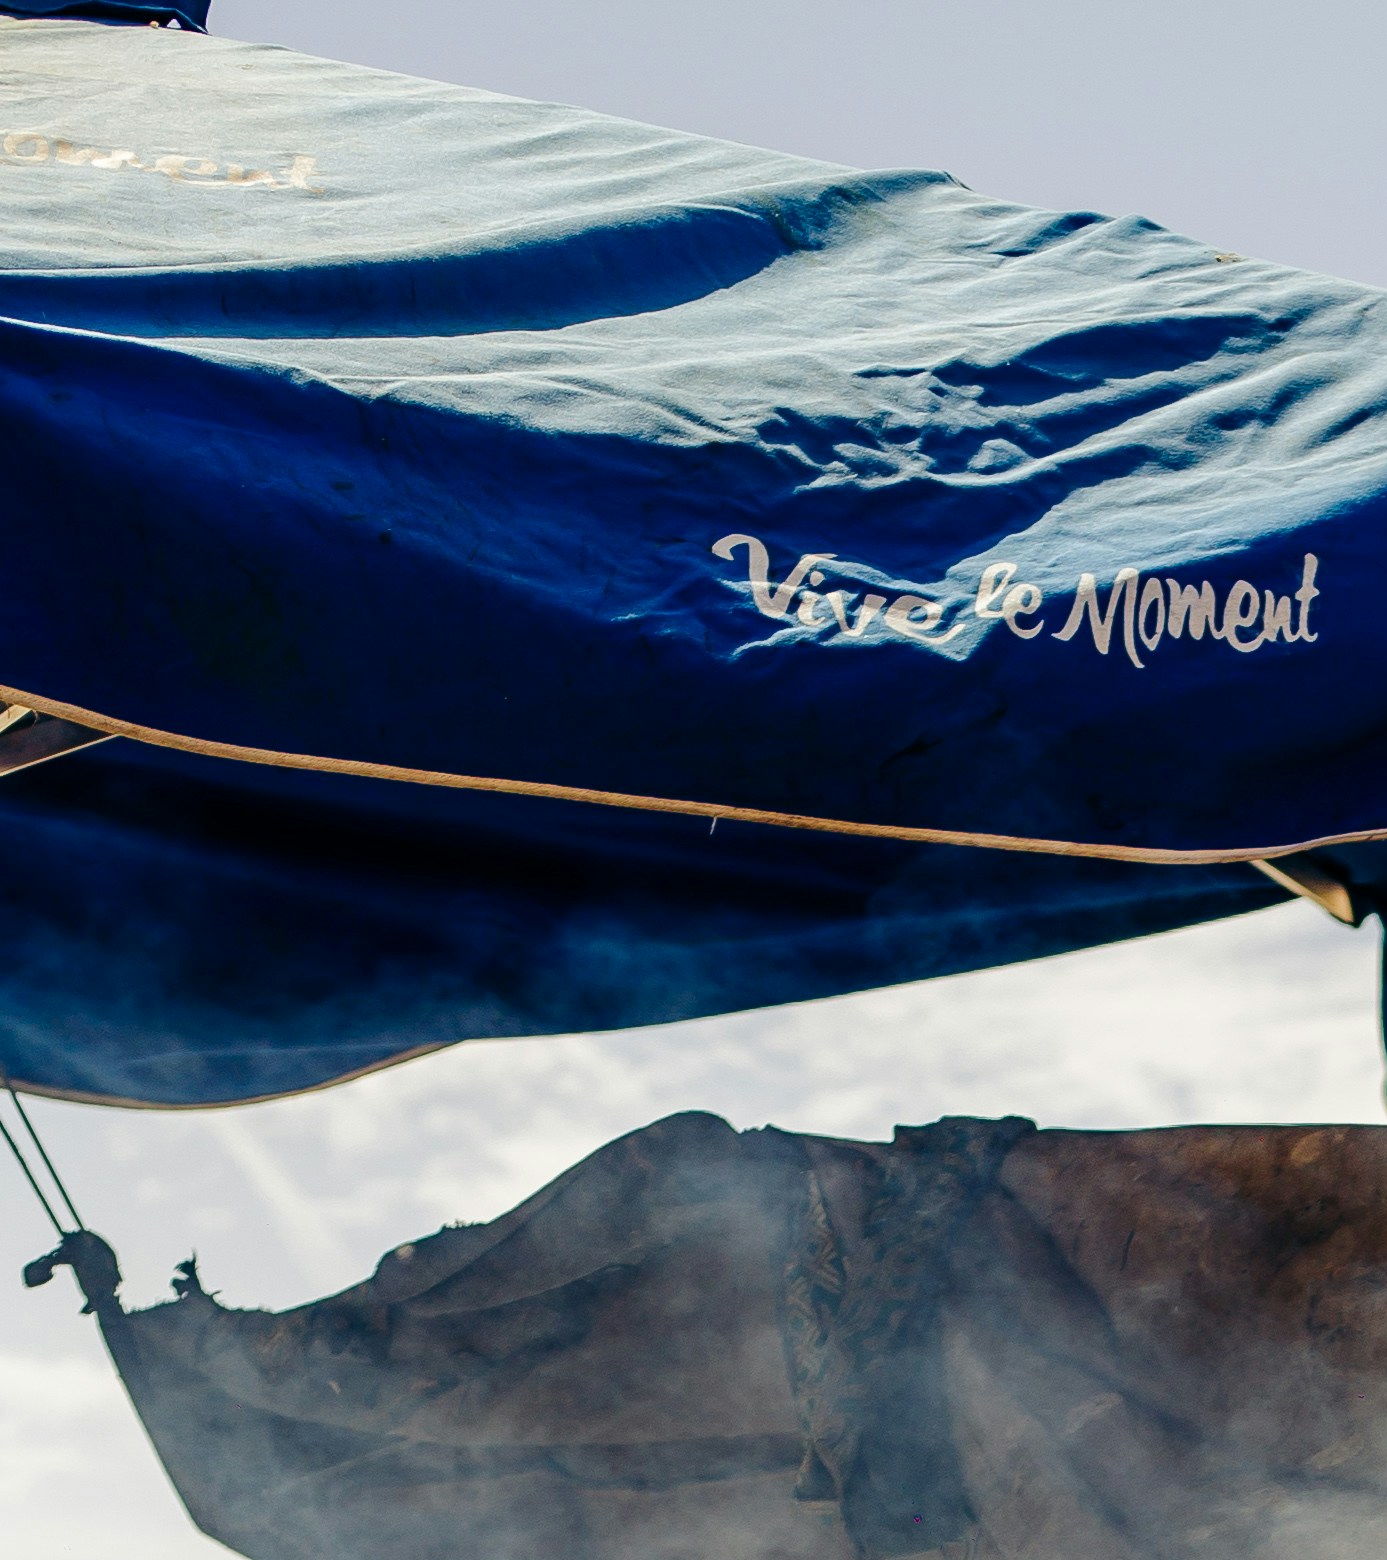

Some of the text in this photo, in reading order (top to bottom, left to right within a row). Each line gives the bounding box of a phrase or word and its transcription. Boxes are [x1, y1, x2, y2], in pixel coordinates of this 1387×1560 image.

[2, 132, 325, 193] oment
[711, 533, 1319, 669] Vive le Moment
